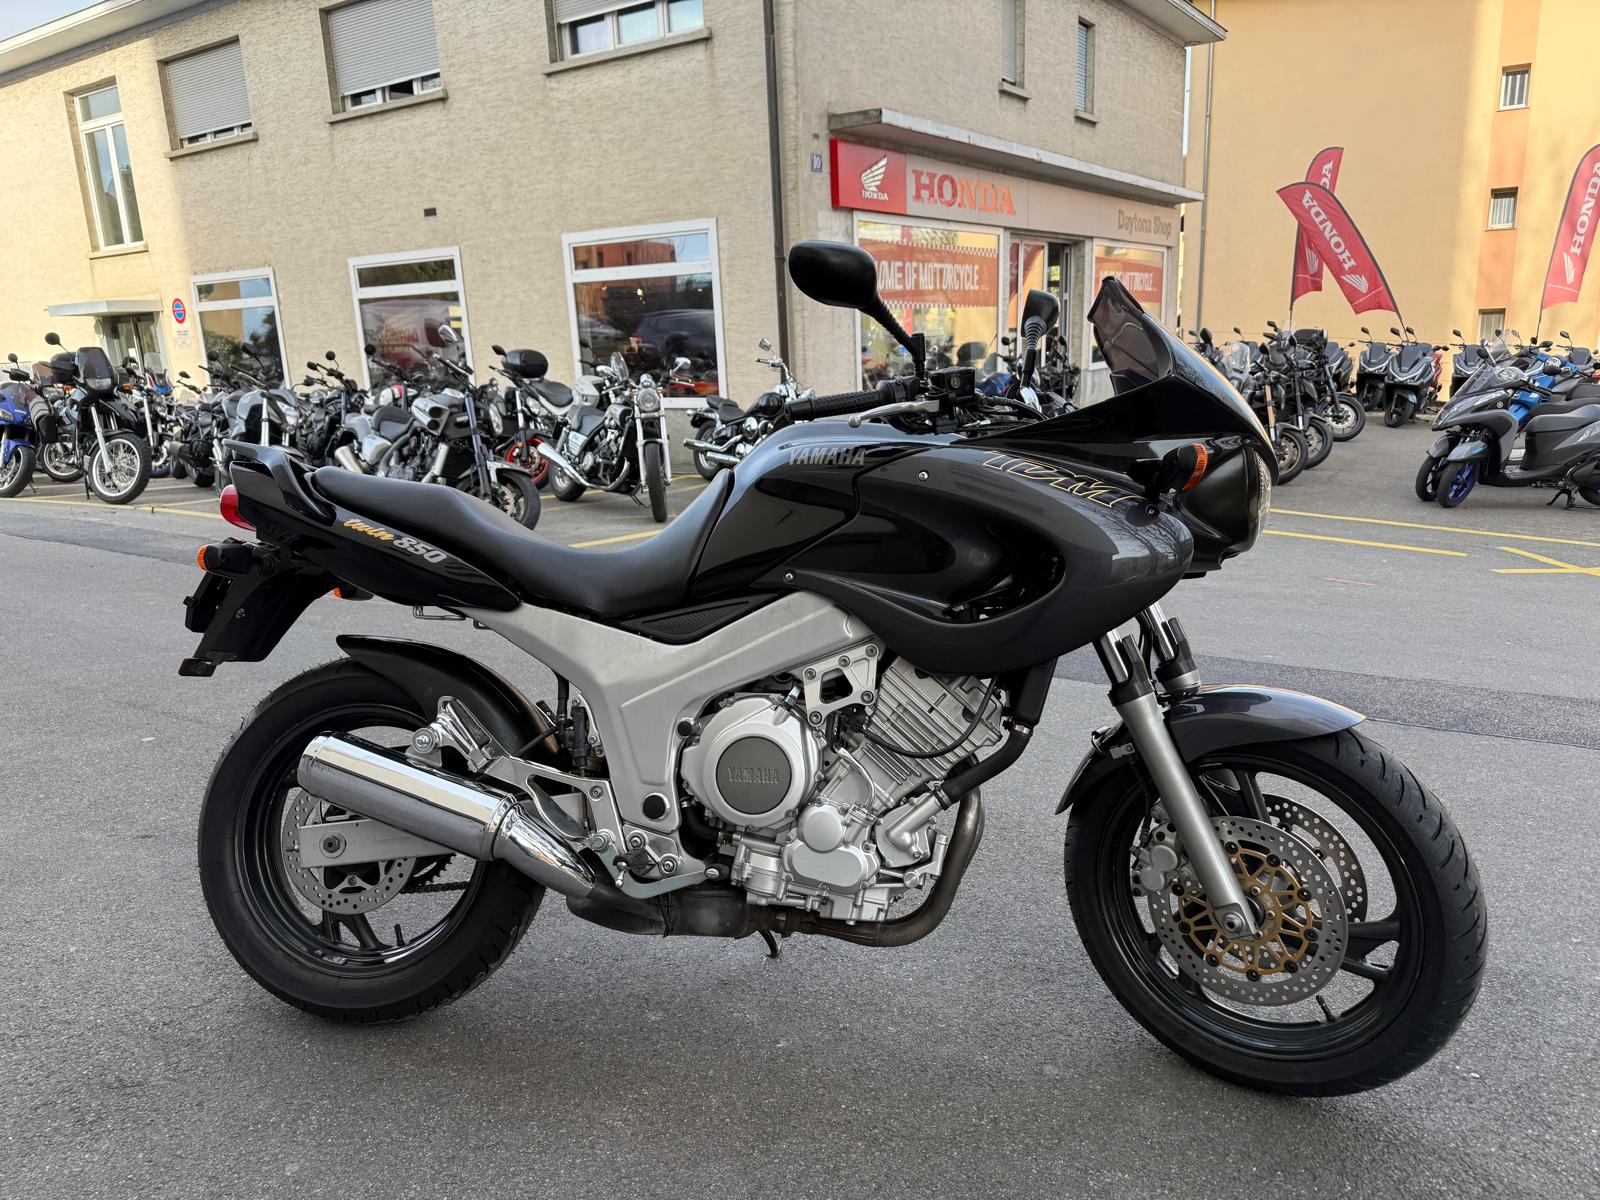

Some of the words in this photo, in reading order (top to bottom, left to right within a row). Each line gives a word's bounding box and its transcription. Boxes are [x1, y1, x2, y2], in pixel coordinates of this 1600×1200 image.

[861, 190, 889, 201] HONDA
[912, 168, 1016, 216] HONDA
[1118, 209, 1152, 235] Daytona
[1153, 215, 1171, 240] Shop
[1301, 189, 1357, 271] HONDA
[905, 261, 918, 290] OF
[789, 447, 866, 465] YAMAHA
[982, 450, 1146, 508] TDM
[343, 518, 395, 541] twin
[393, 537, 448, 563] 850
[728, 766, 779, 784] YAMAHA
